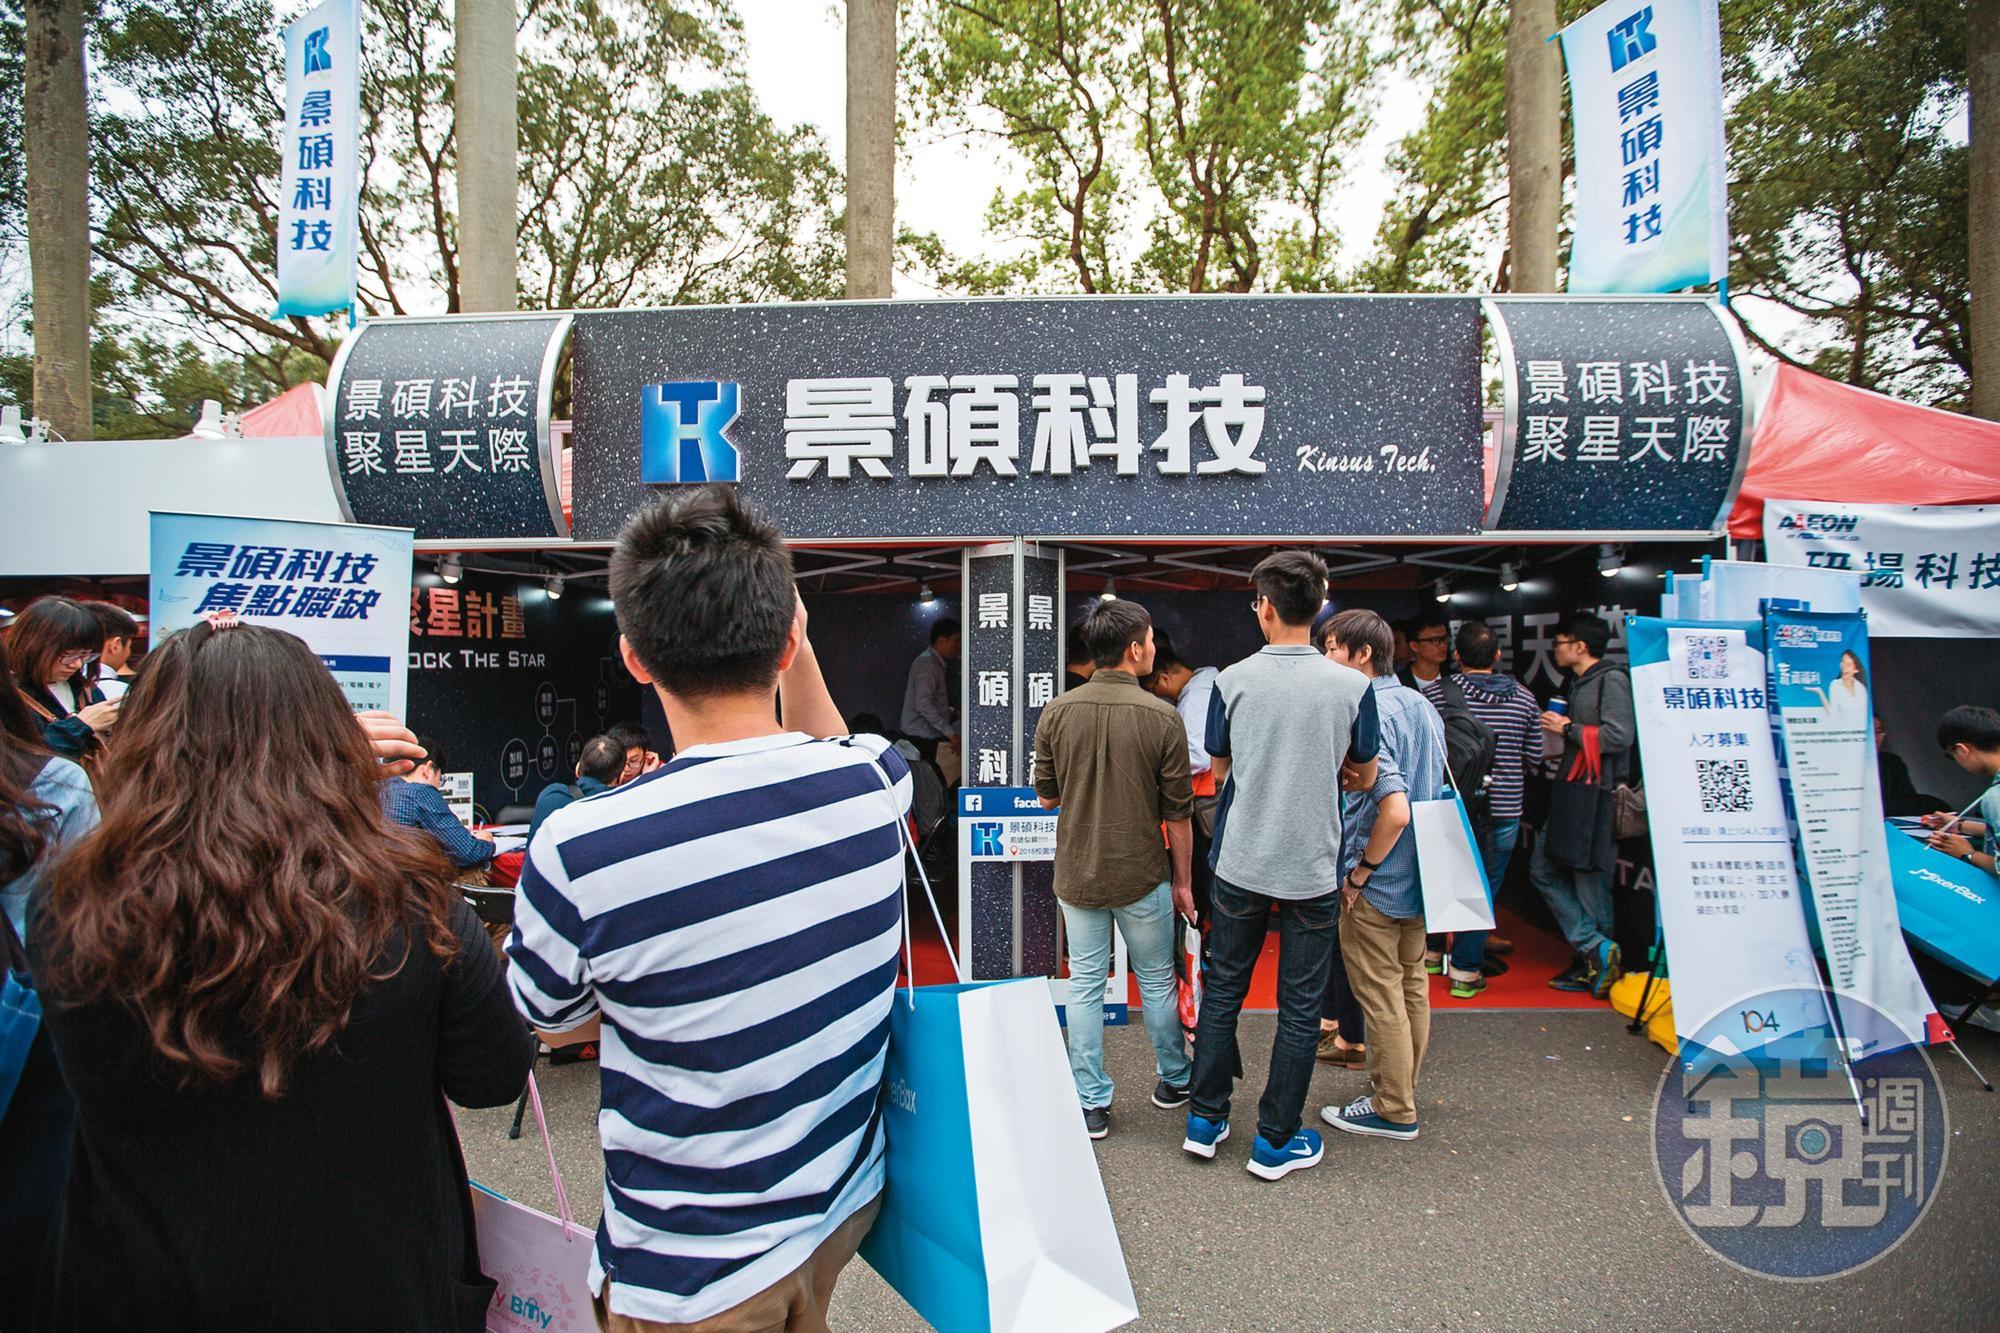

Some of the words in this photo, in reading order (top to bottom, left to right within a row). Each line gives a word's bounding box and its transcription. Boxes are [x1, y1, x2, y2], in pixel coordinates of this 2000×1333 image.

[291, 89, 334, 252] 景碩科技
[1616, 70, 1663, 245] 景碩科技
[345, 375, 529, 421] 景碩科技
[1525, 360, 1730, 406] 景碩科技
[783, 373, 1267, 480] 景碩科技
[1523, 415, 1730, 462] 聚星天際
[345, 428, 531, 474] 聚星天際
[1296, 444, 1374, 473] Kinsus
[1380, 444, 1436, 473] Tech.
[175, 542, 378, 585] 景碩科技
[193, 582, 382, 620] 焦點職缺
[409, 650, 453, 669] OCK
[460, 650, 500, 668] THE
[508, 650, 546, 668] STAR
[977, 592, 1010, 785] 景碩科
[1028, 594, 1054, 784] 景碩
[1663, 687, 1766, 709] 景碩科技
[1688, 732, 1750, 748] 人才募集
[1010, 821, 1056, 834] 景碩科技
[1740, 1009, 1781, 1034] 104
[890, 1078, 917, 1115] erBox
